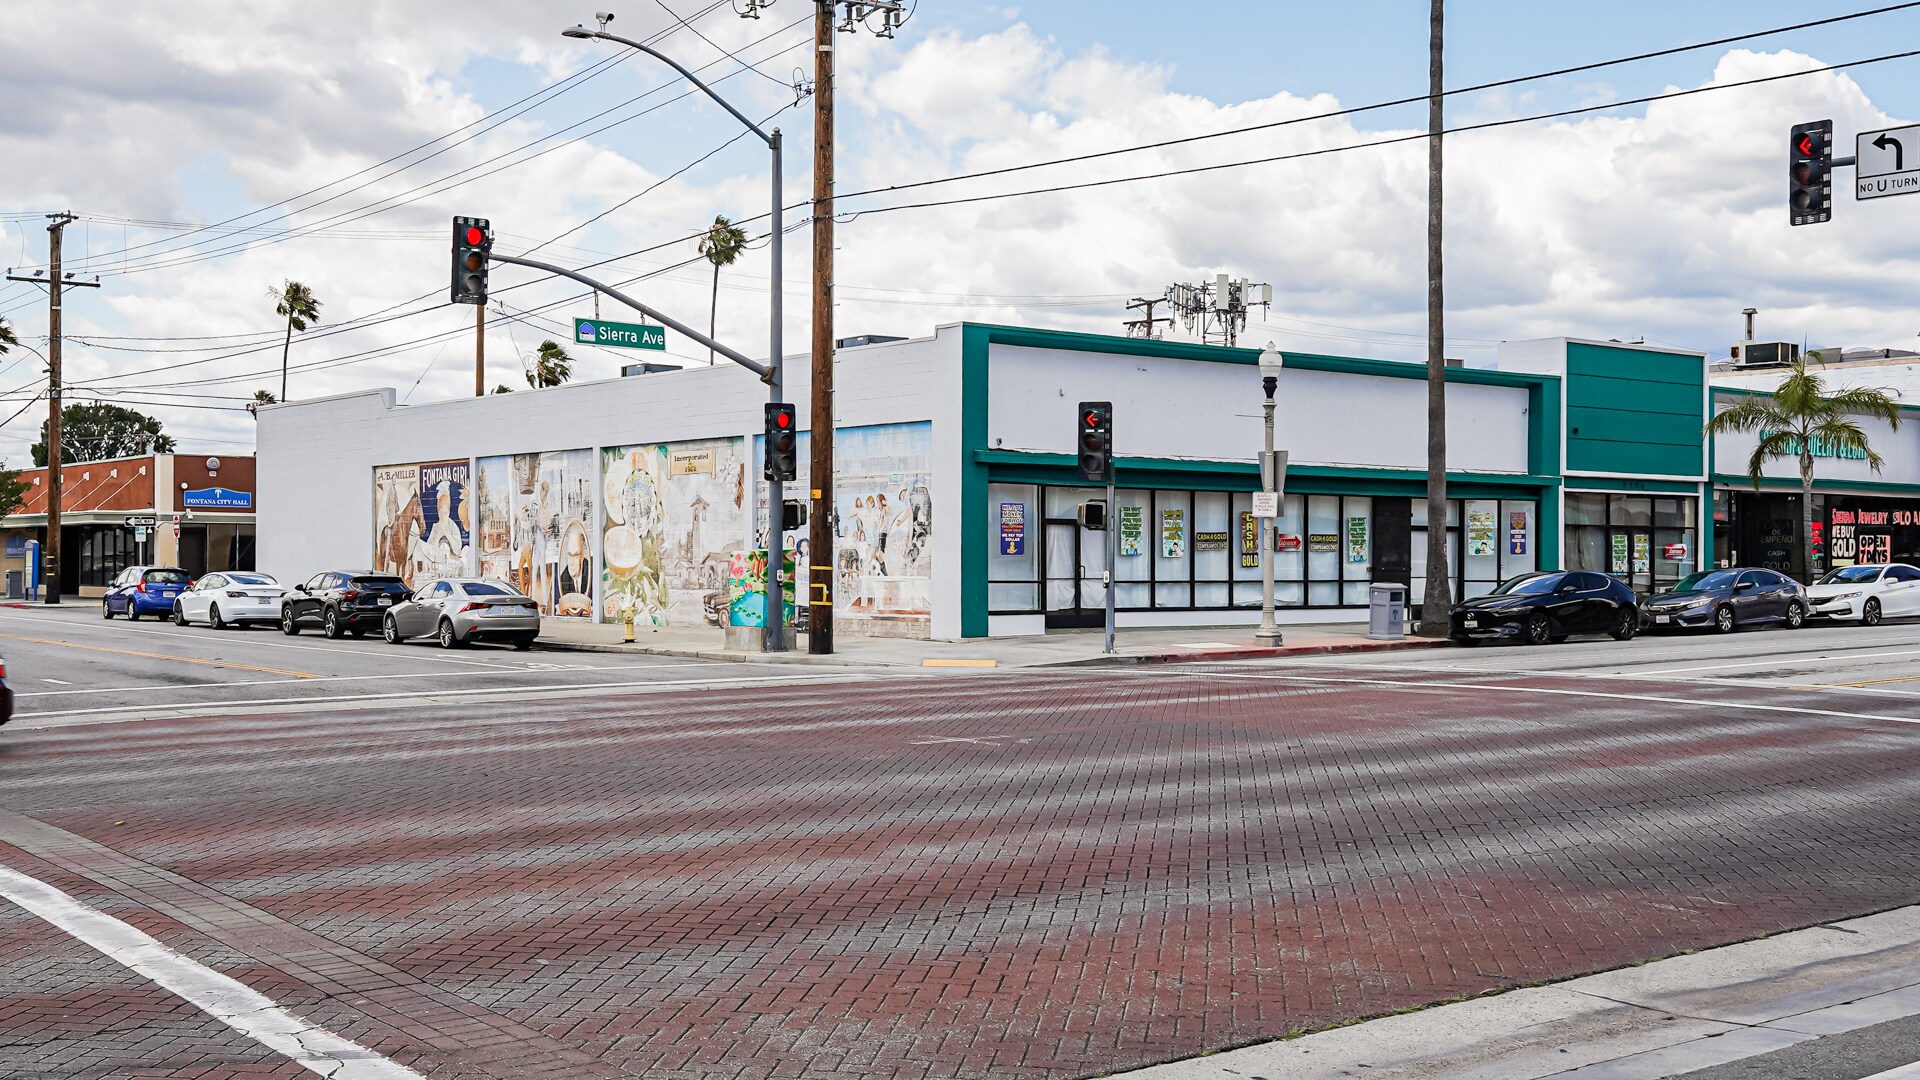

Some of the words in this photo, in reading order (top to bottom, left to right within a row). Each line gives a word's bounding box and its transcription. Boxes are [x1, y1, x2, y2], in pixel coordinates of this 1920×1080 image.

[1860, 183, 1873, 193] NO
[1877, 179, 1887, 192] U
[1891, 177, 1918, 188] TURN
[599, 326, 638, 342] Sierra
[642, 331, 664, 345] Ave
[674, 453, 709, 462] Incorporated
[392, 469, 416, 480] MILLER
[422, 467, 452, 493] FONTANA
[1832, 508, 1855, 525] SIERRA
[1858, 508, 1888, 525] JEWELRY
[1246, 513, 1254, 549] CASH
[1841, 526, 1856, 539] BUY
[1832, 539, 1856, 557] GOLD
[1860, 536, 1887, 548] OPEN
[1242, 554, 1259, 567] GOLD
[1860, 549, 1867, 564] 7
[1762, 561, 1791, 570] GOLD
